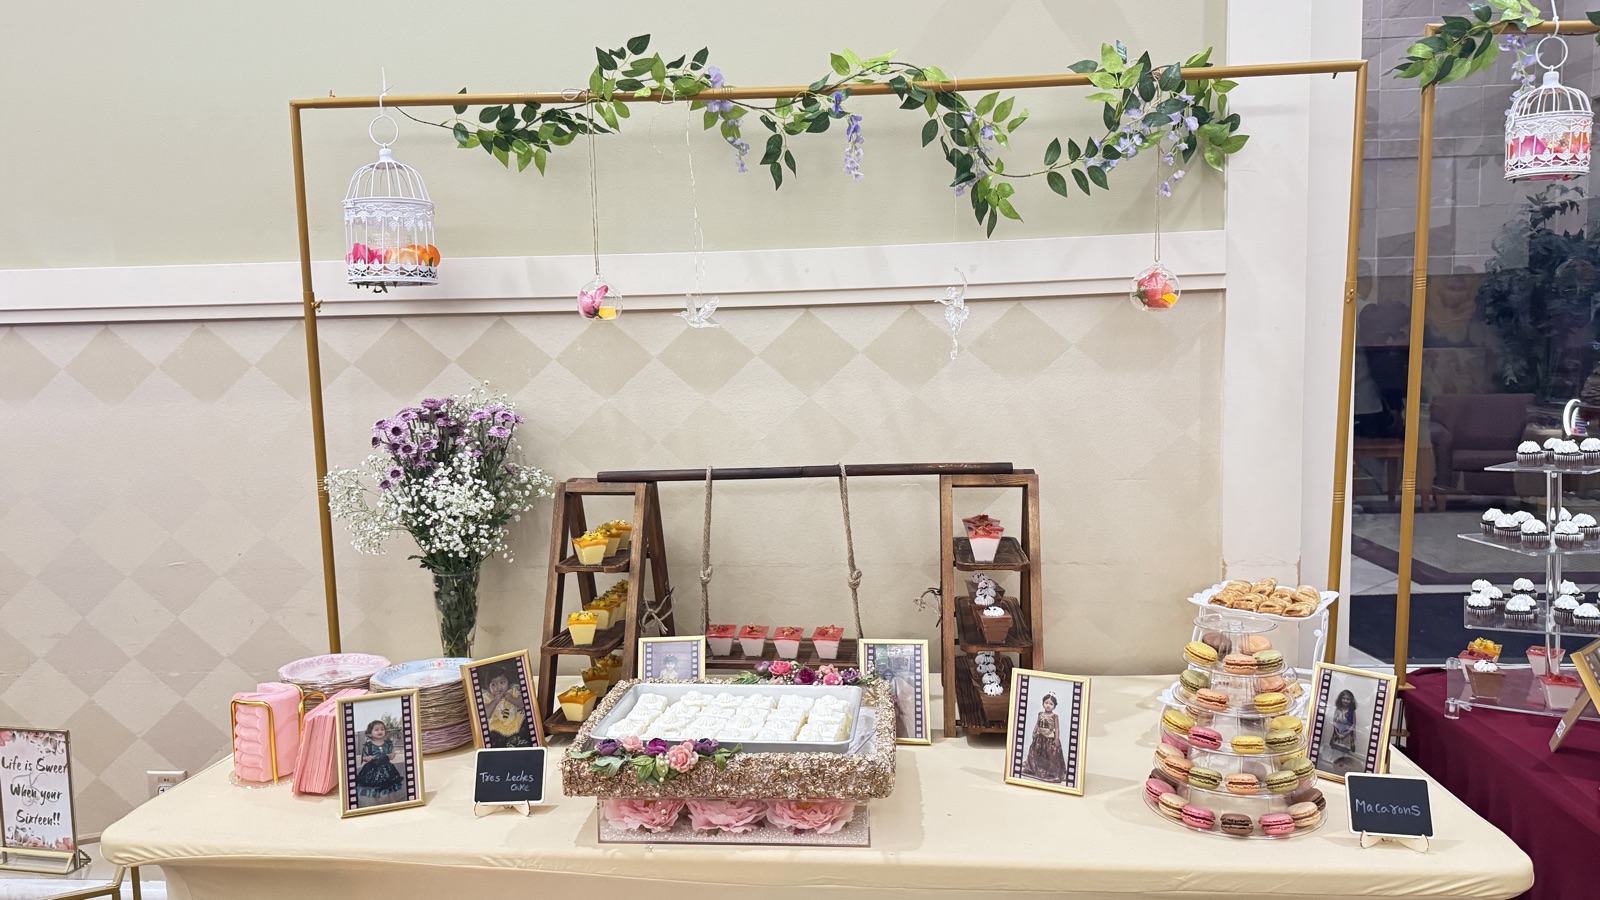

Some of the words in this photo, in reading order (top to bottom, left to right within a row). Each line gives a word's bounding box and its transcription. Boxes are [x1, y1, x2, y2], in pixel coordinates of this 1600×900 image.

[1, 756, 21, 771] Life
[25, 760, 33, 772] is
[479, 771, 501, 783] Tres
[505, 770, 534, 783] Leches
[10, 783, 37, 798] When
[40, 790, 62, 806] your
[16, 809, 61, 826] Sixteen!!
